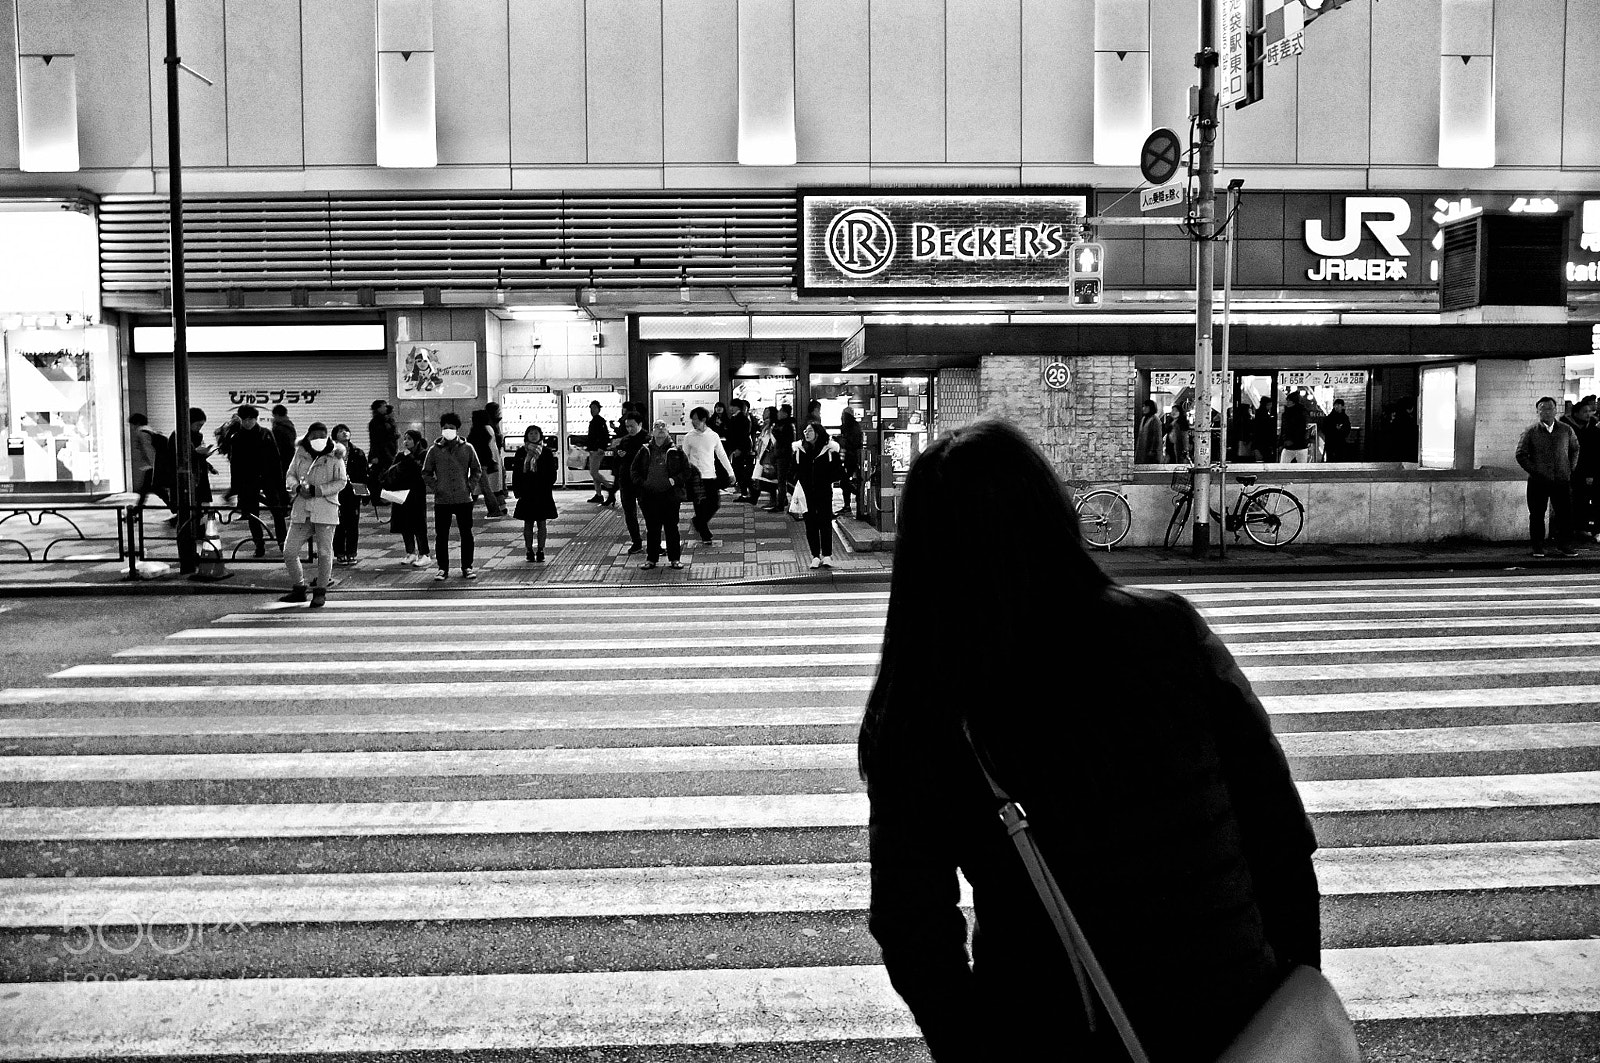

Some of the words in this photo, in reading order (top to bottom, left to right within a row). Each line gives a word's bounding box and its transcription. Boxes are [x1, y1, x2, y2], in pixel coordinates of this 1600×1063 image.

[1267, 32, 1304, 63] 時差式
[1305, 197, 1411, 256] JR
[916, 224, 1063, 257] BECKER'S
[1307, 258, 1407, 281] JR東日本
[1049, 368, 1066, 382] 26
[228, 389, 321, 404] びゅうプラザ
